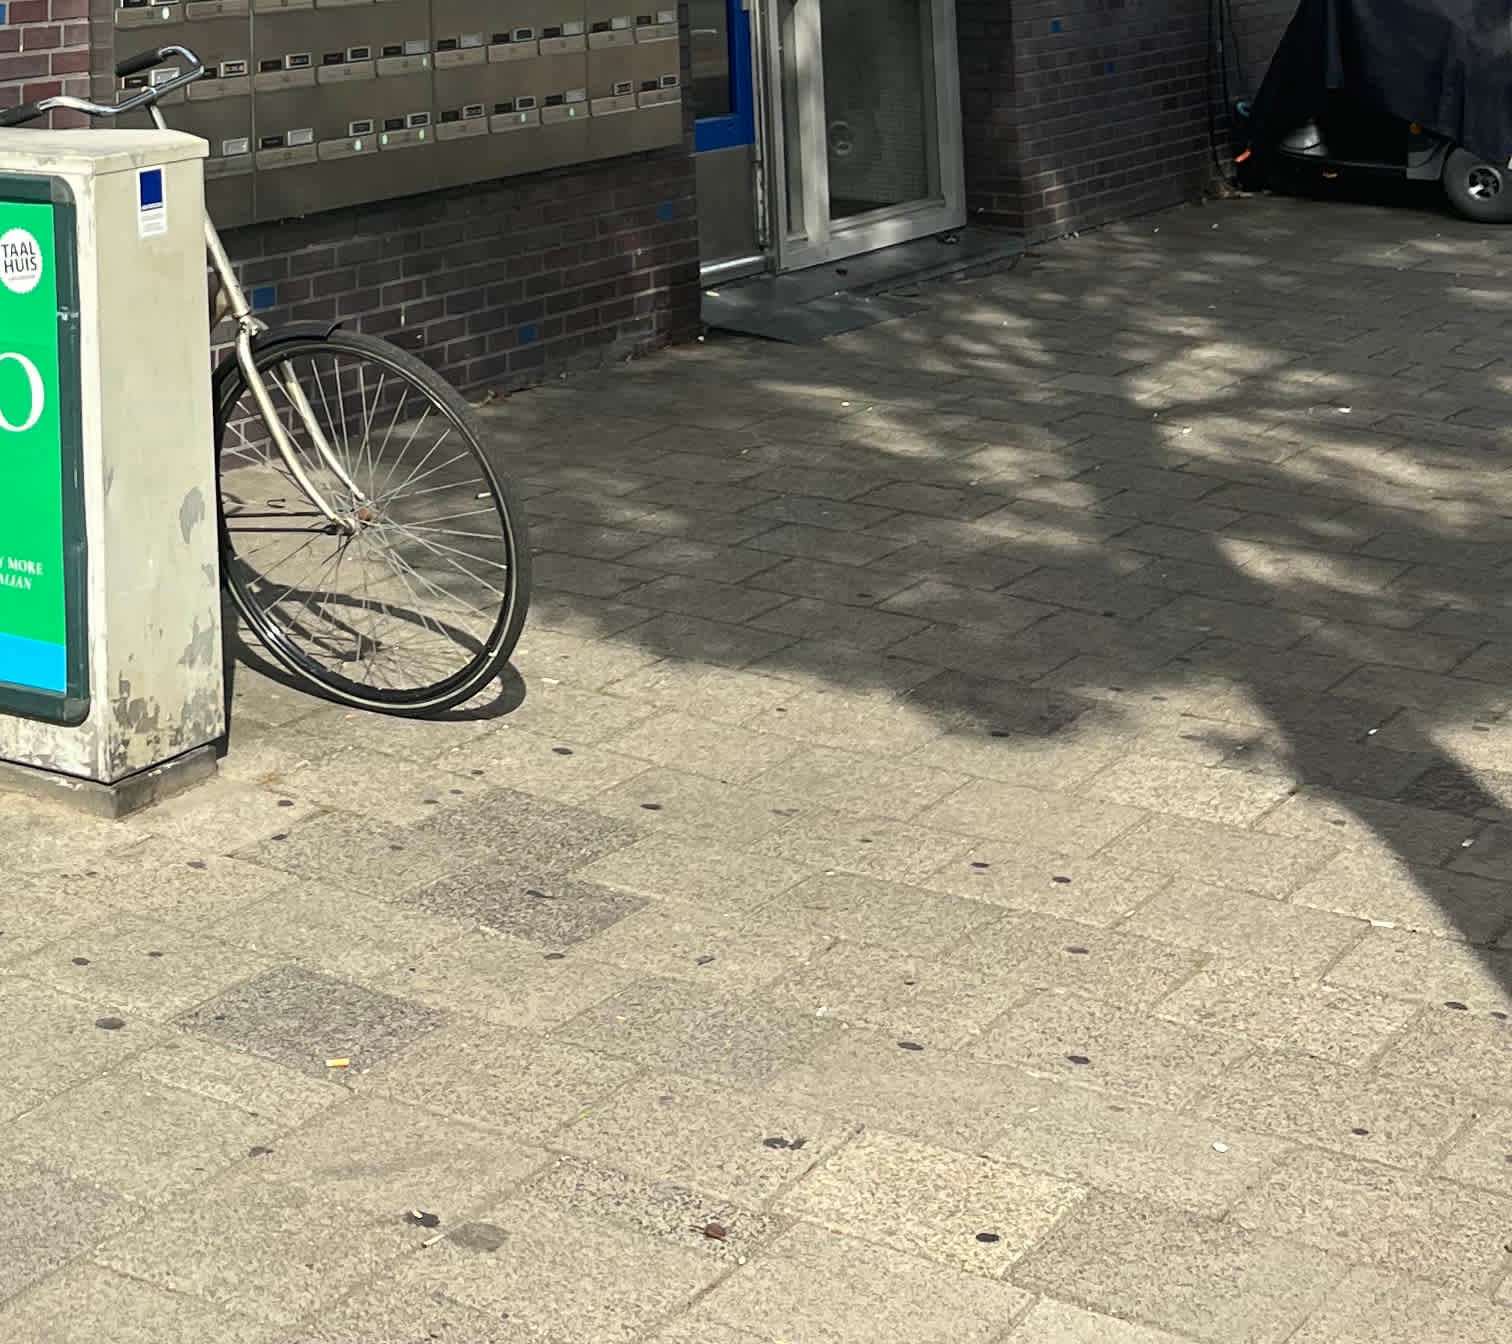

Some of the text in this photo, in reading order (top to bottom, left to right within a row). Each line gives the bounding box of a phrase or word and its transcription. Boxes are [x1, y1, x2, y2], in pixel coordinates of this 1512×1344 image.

[1, 241, 37, 259] TAAL
[3, 256, 38, 273] HUIS
[7, 556, 43, 576] MORE
